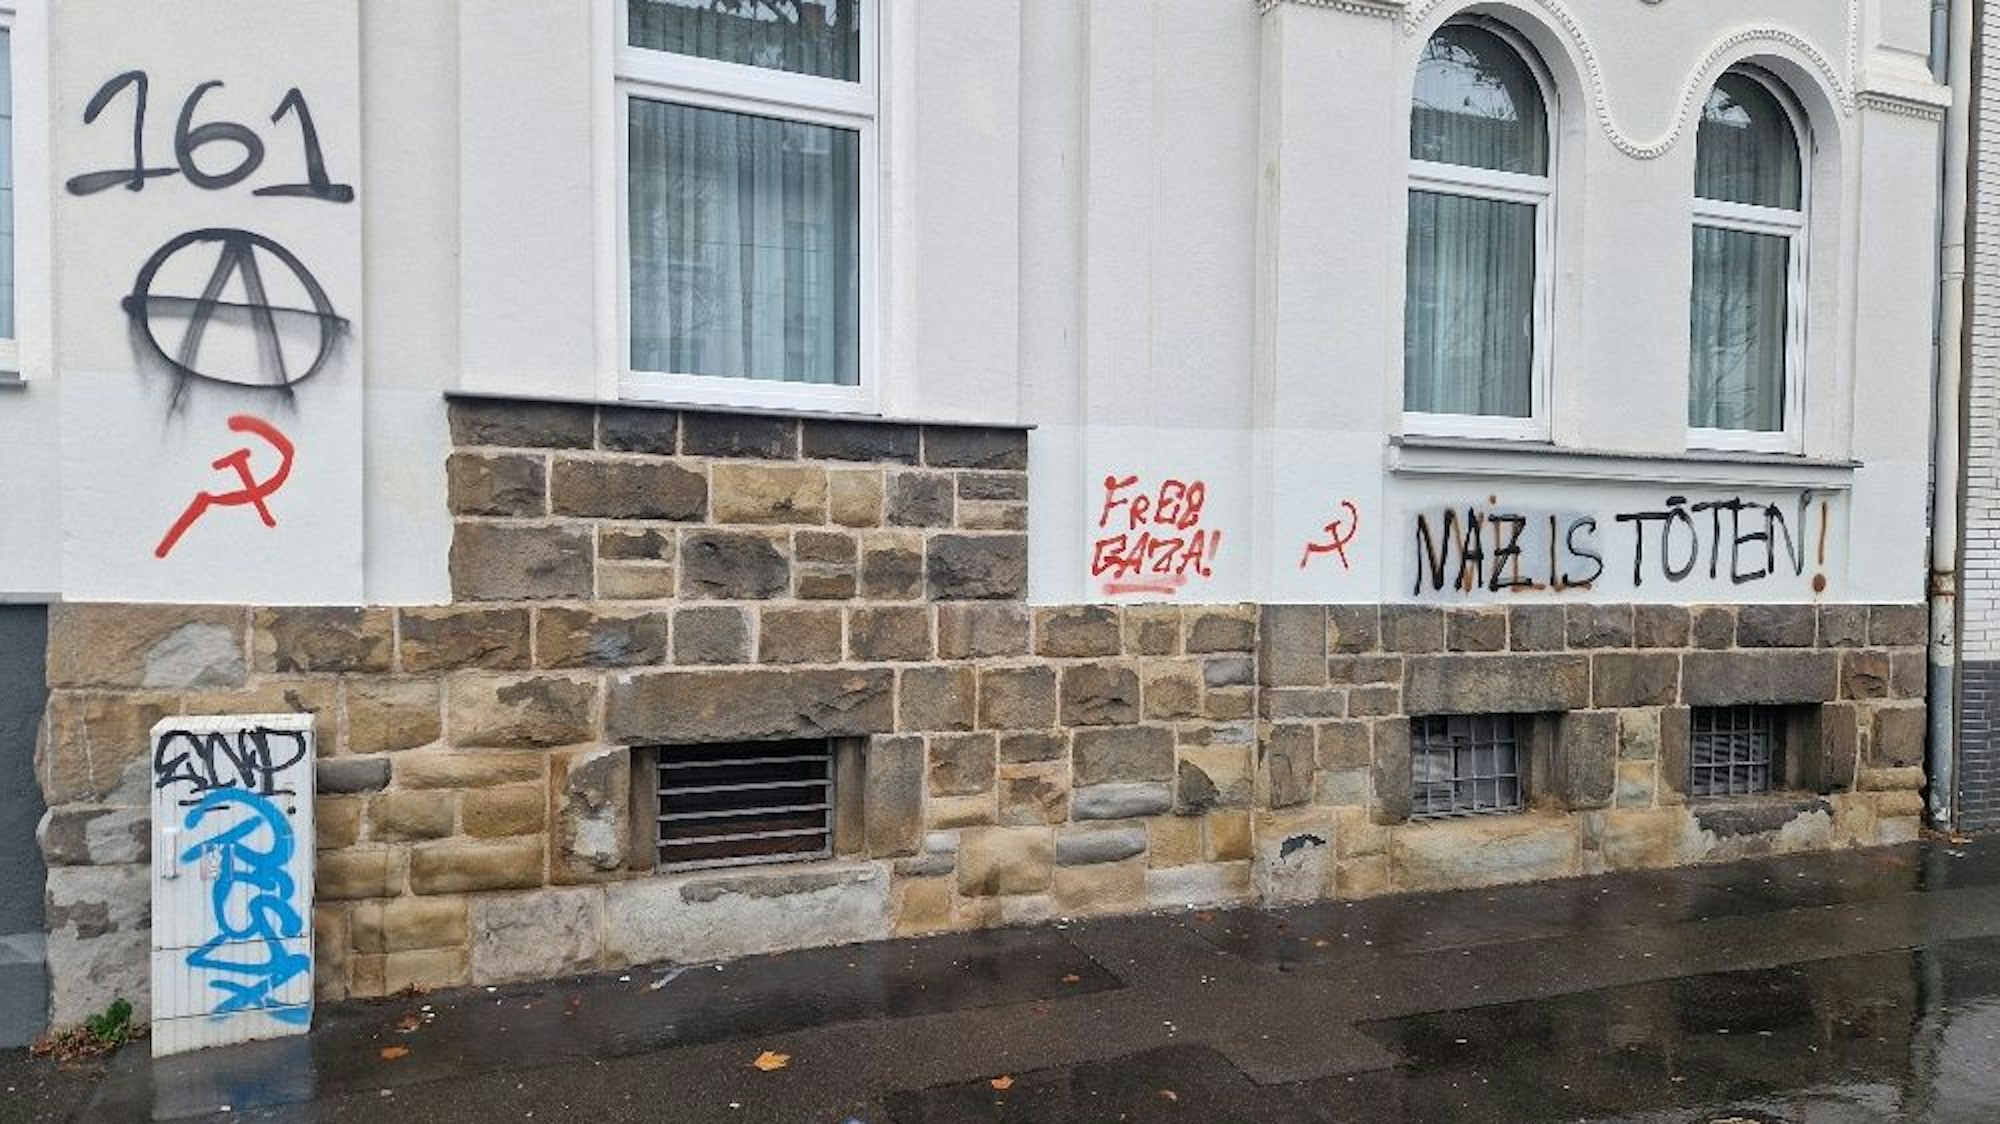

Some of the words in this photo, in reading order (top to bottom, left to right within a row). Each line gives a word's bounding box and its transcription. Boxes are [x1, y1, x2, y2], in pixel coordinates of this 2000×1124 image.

[66, 70, 355, 203] 161
[1091, 529, 1221, 577] GAZA!
[1413, 500, 1603, 595] NAZIS
